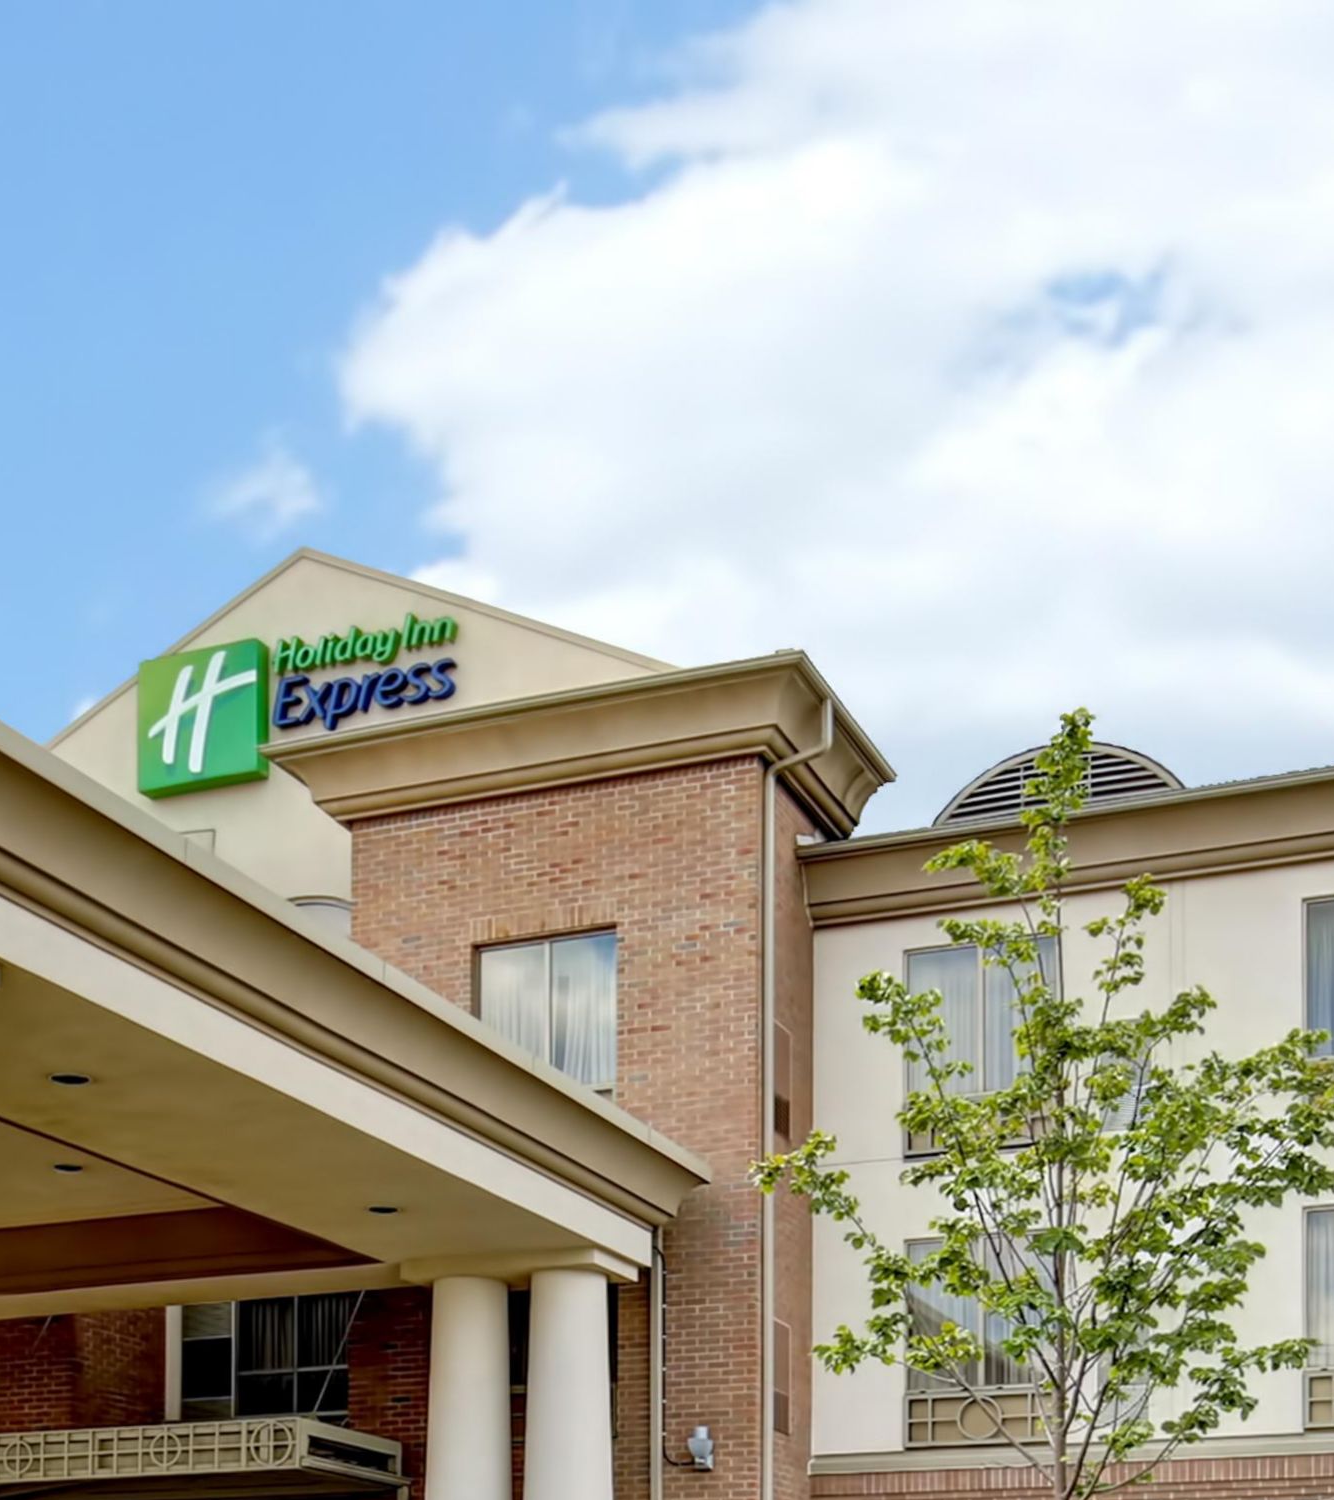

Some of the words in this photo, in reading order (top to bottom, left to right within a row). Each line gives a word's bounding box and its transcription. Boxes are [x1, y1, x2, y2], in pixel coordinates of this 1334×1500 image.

[273, 625, 398, 674] Holiday
[402, 613, 458, 650] Inn
[148, 651, 257, 773] H
[272, 657, 457, 731] Express
